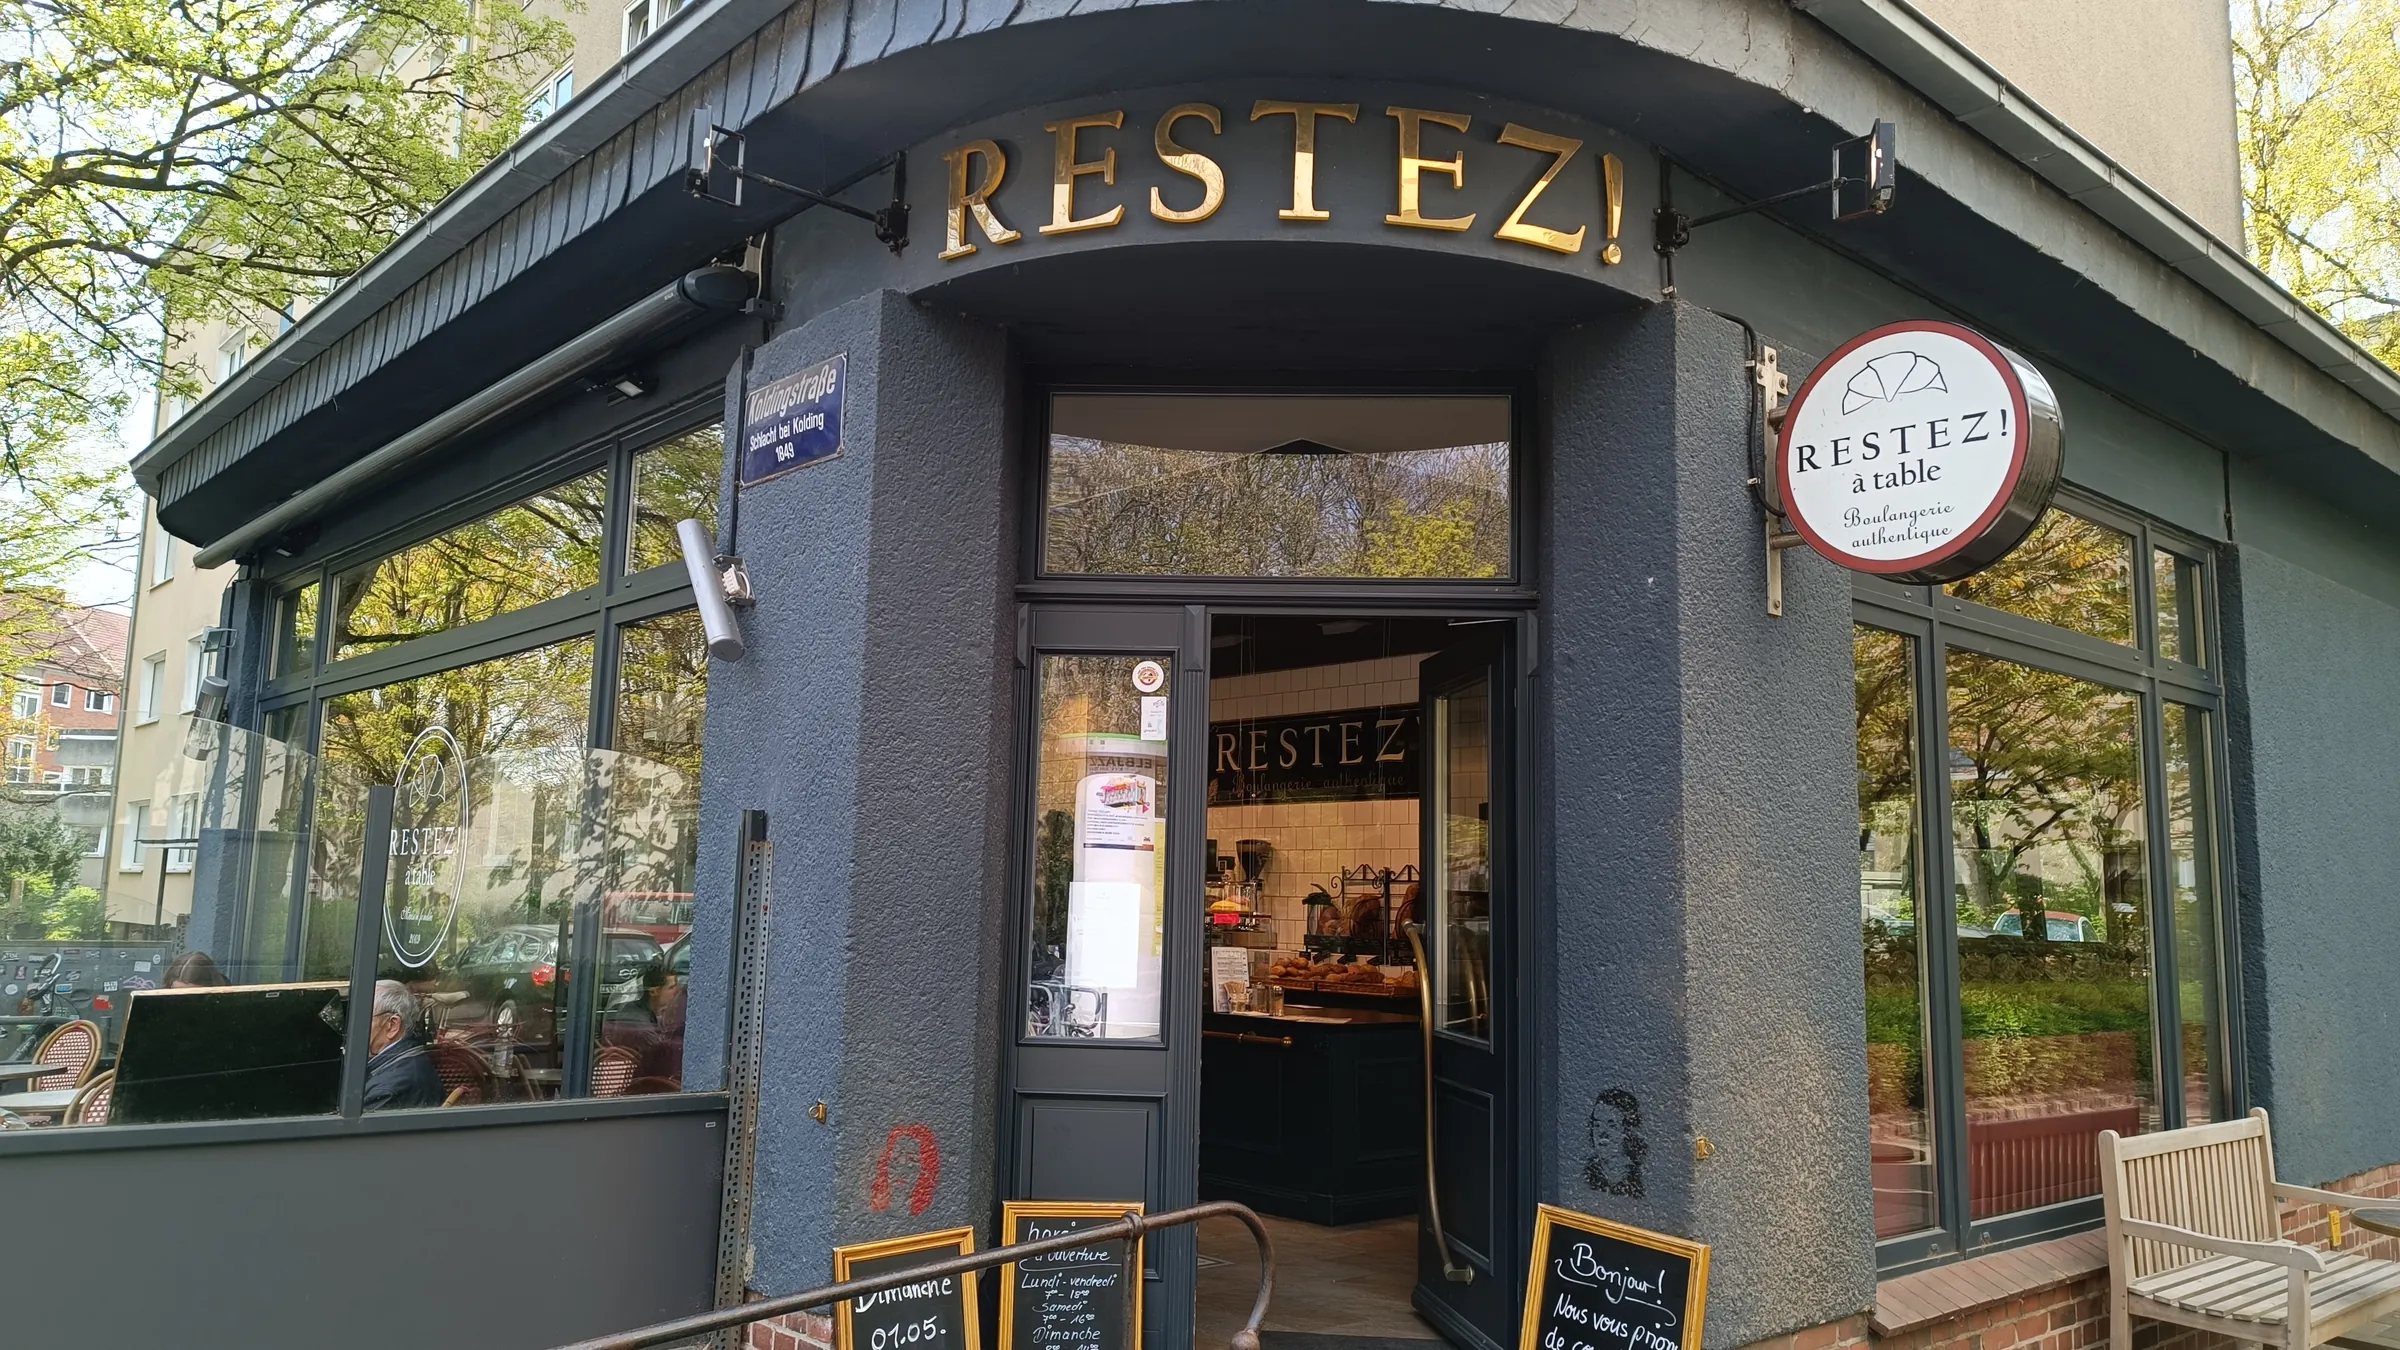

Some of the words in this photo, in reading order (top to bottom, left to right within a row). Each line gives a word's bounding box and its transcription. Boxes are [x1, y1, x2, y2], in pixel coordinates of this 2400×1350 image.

[938, 101, 1624, 265] RESTEZ!
[748, 364, 837, 427] Koldingstraße
[750, 426, 777, 452] Schlacht
[779, 420, 790, 439] bei
[793, 412, 824, 435] Kolding
[1796, 408, 2008, 473] RESTEZ!
[775, 441, 795, 463] 1849
[1852, 473, 1866, 494] à
[1873, 459, 1941, 491] table
[1843, 501, 1955, 529] Boulangerie
[1851, 525, 1953, 549] authentique
[411, 862, 436, 886] table
[1021, 1272, 1063, 1289] Lundi
[1070, 1273, 1118, 1288] vendredi
[1569, 1243, 1666, 1305] Bonjour!
[1553, 1292, 1588, 1324] Nous
[1593, 1312, 1628, 1337] vous
[871, 1315, 947, 1350] 01.05.
[1032, 1324, 1101, 1343] Dimanche
